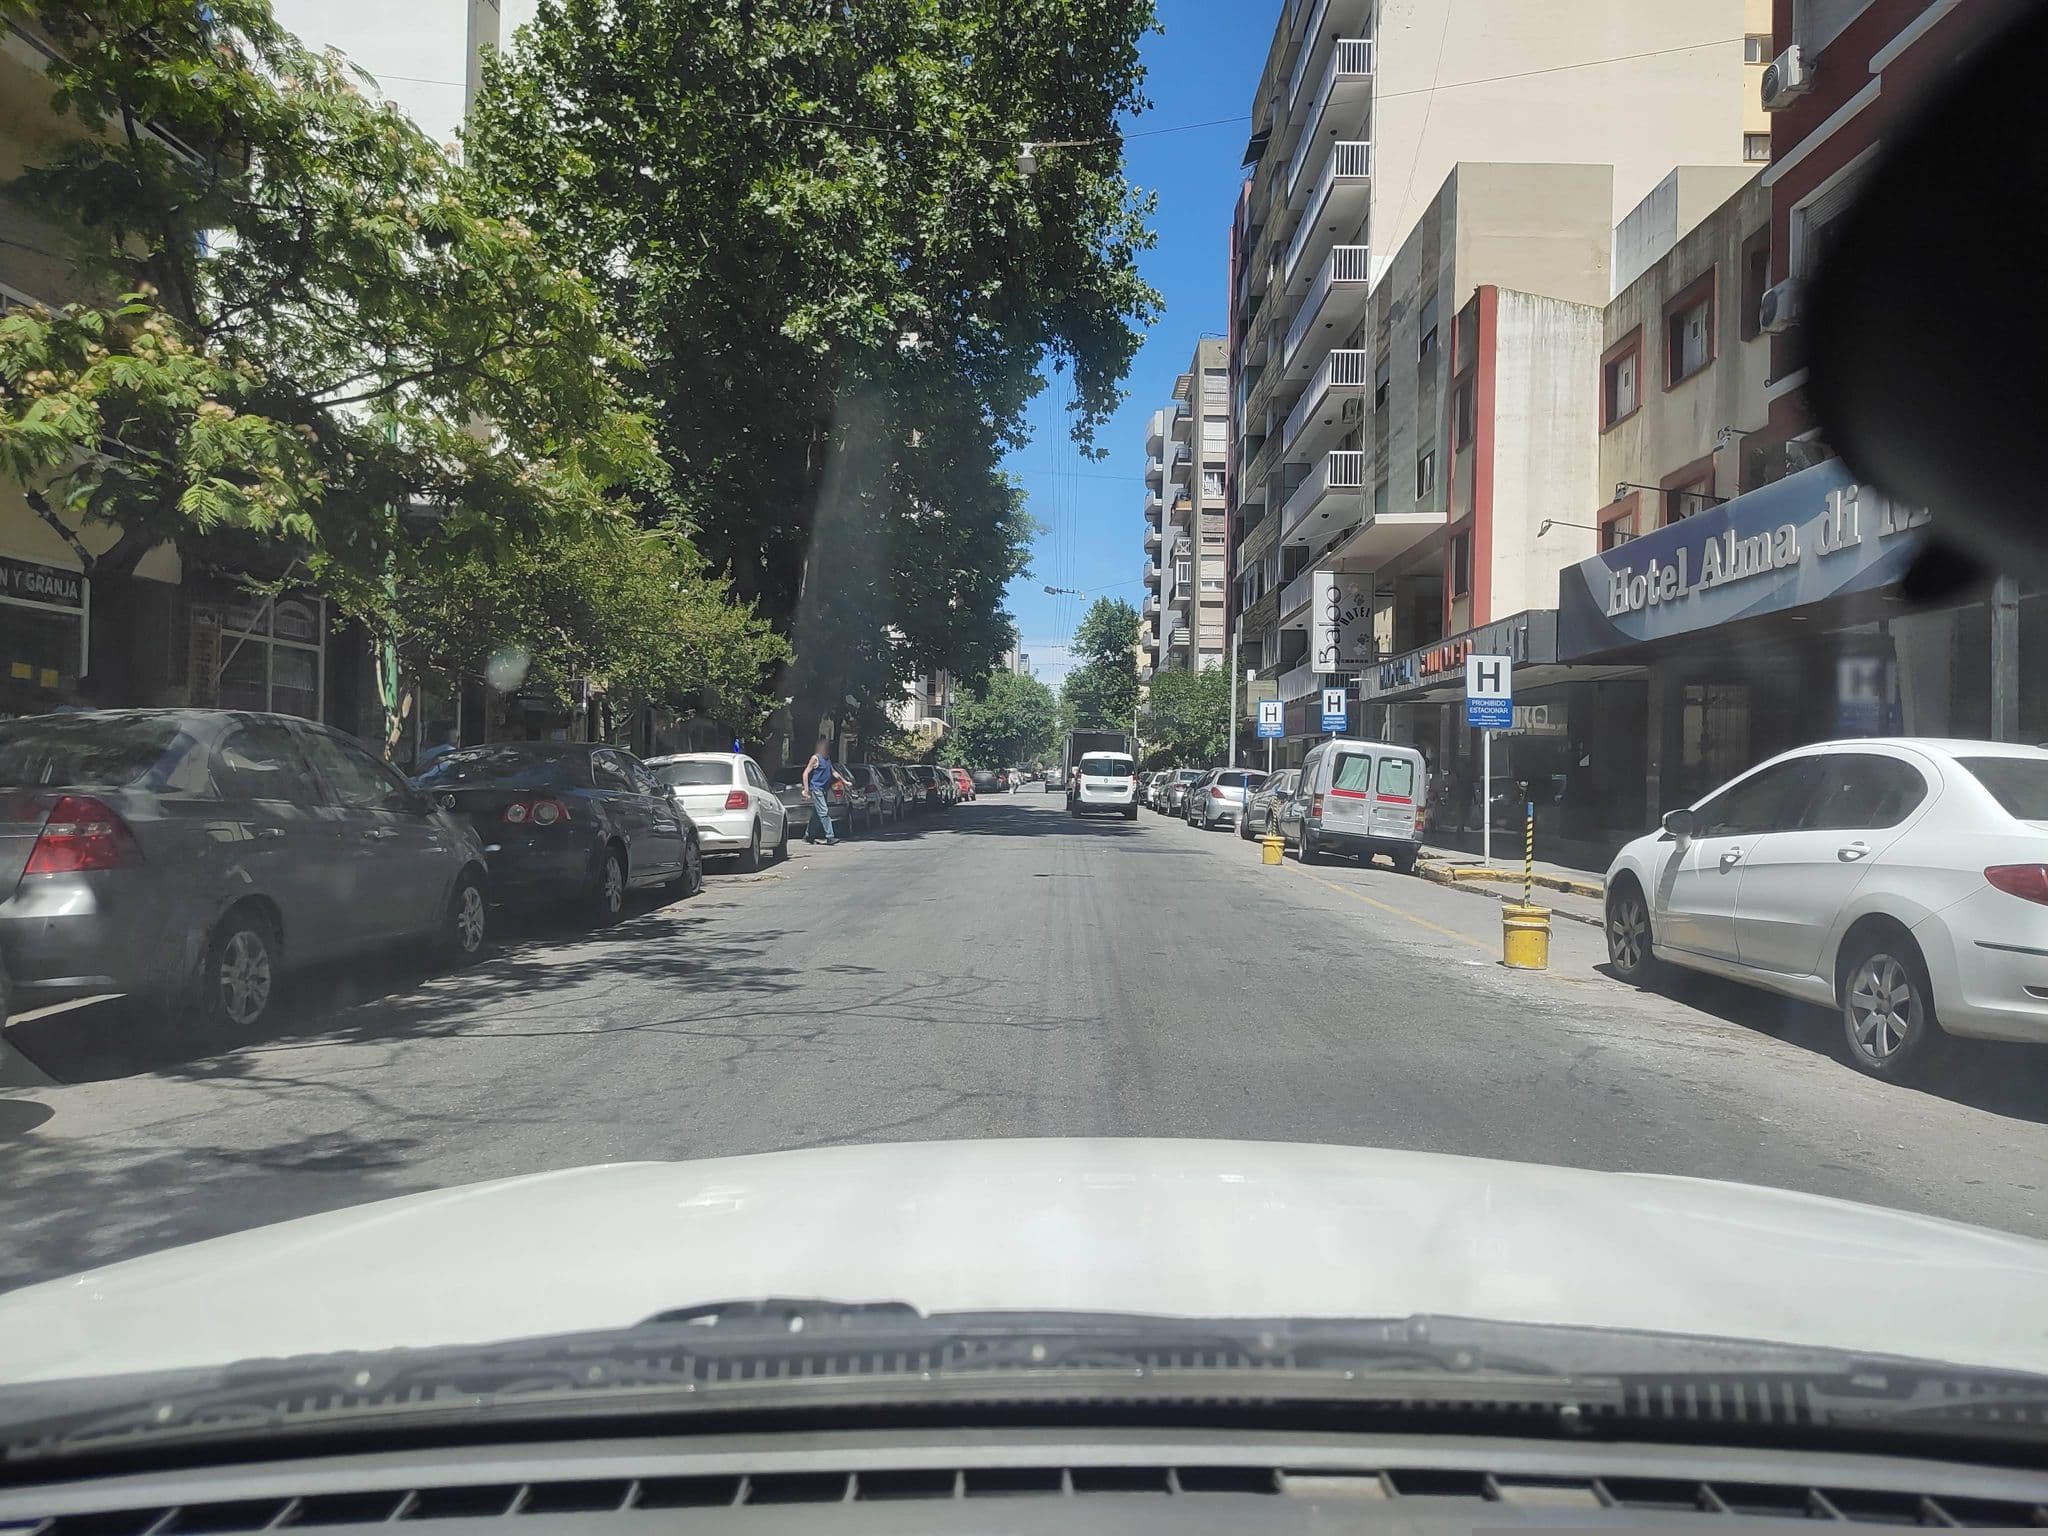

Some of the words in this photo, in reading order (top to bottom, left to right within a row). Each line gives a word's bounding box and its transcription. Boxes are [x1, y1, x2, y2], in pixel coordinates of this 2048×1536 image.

[1606, 546, 1690, 617] Hotel
[1699, 522, 1801, 591] Alma
[1815, 484, 1862, 556] di
[25, 572, 78, 599] GRANJA
[1318, 586, 1341, 665] Baloo
[1339, 606, 1371, 626] HOTEL
[1477, 661, 1500, 692] H
[1265, 706, 1277, 722] H
[1328, 696, 1340, 712] H
